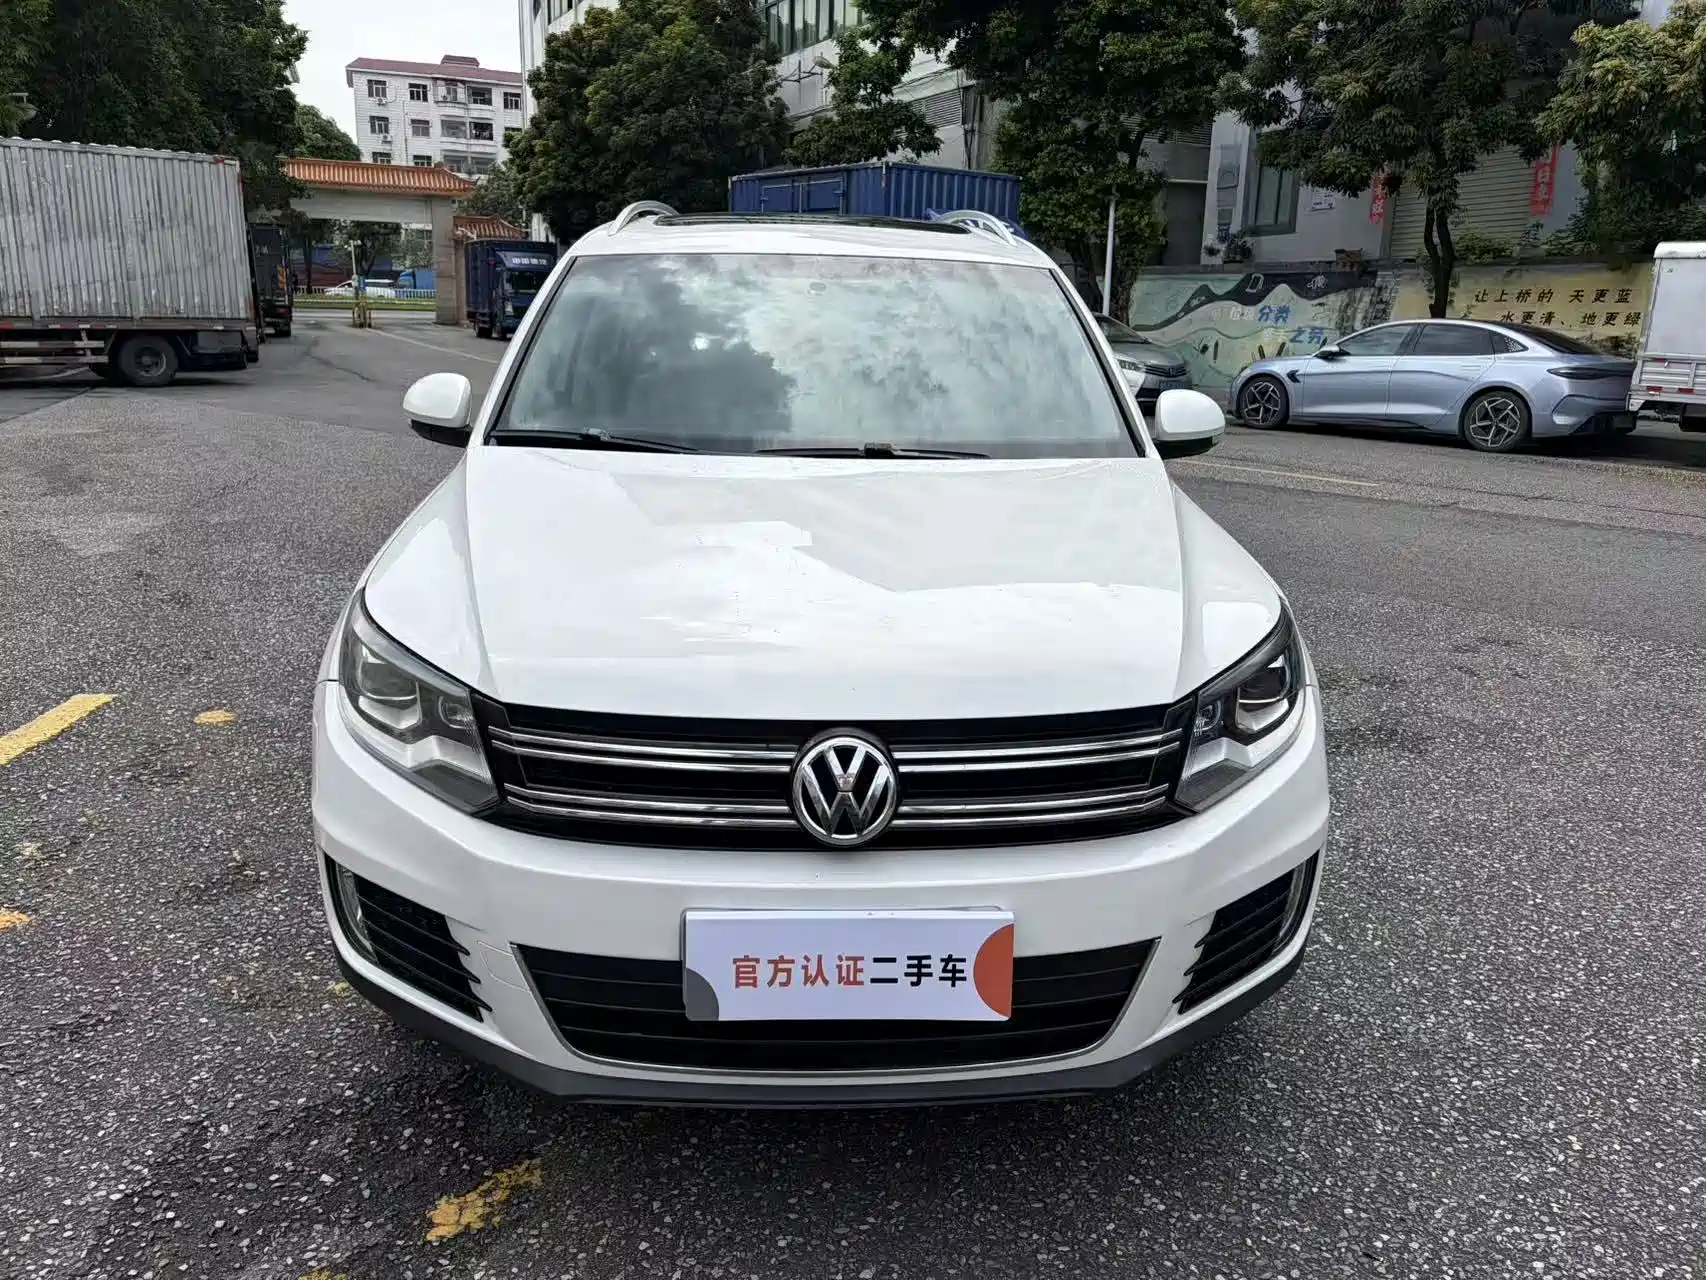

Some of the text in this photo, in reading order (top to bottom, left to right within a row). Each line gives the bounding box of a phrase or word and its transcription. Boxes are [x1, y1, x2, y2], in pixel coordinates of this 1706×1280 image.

[732, 954, 967, 989] 官方认证二手车
